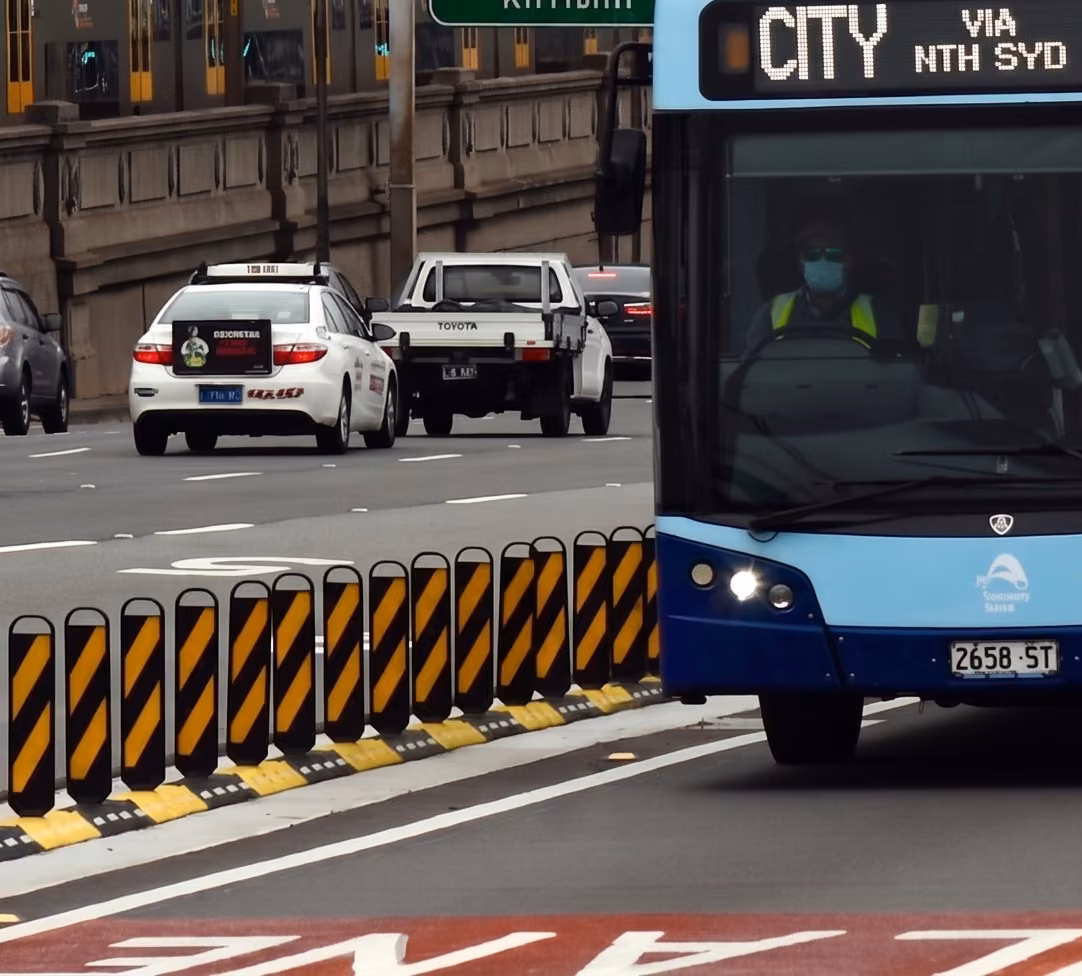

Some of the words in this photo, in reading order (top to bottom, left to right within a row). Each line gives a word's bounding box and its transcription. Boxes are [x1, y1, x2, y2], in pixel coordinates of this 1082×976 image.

[961, 7, 1017, 38] VIA
[759, 3, 888, 81] CITY
[914, 43, 980, 73] NTH
[994, 41, 1067, 71] SYD
[437, 321, 478, 332] TOYOTA
